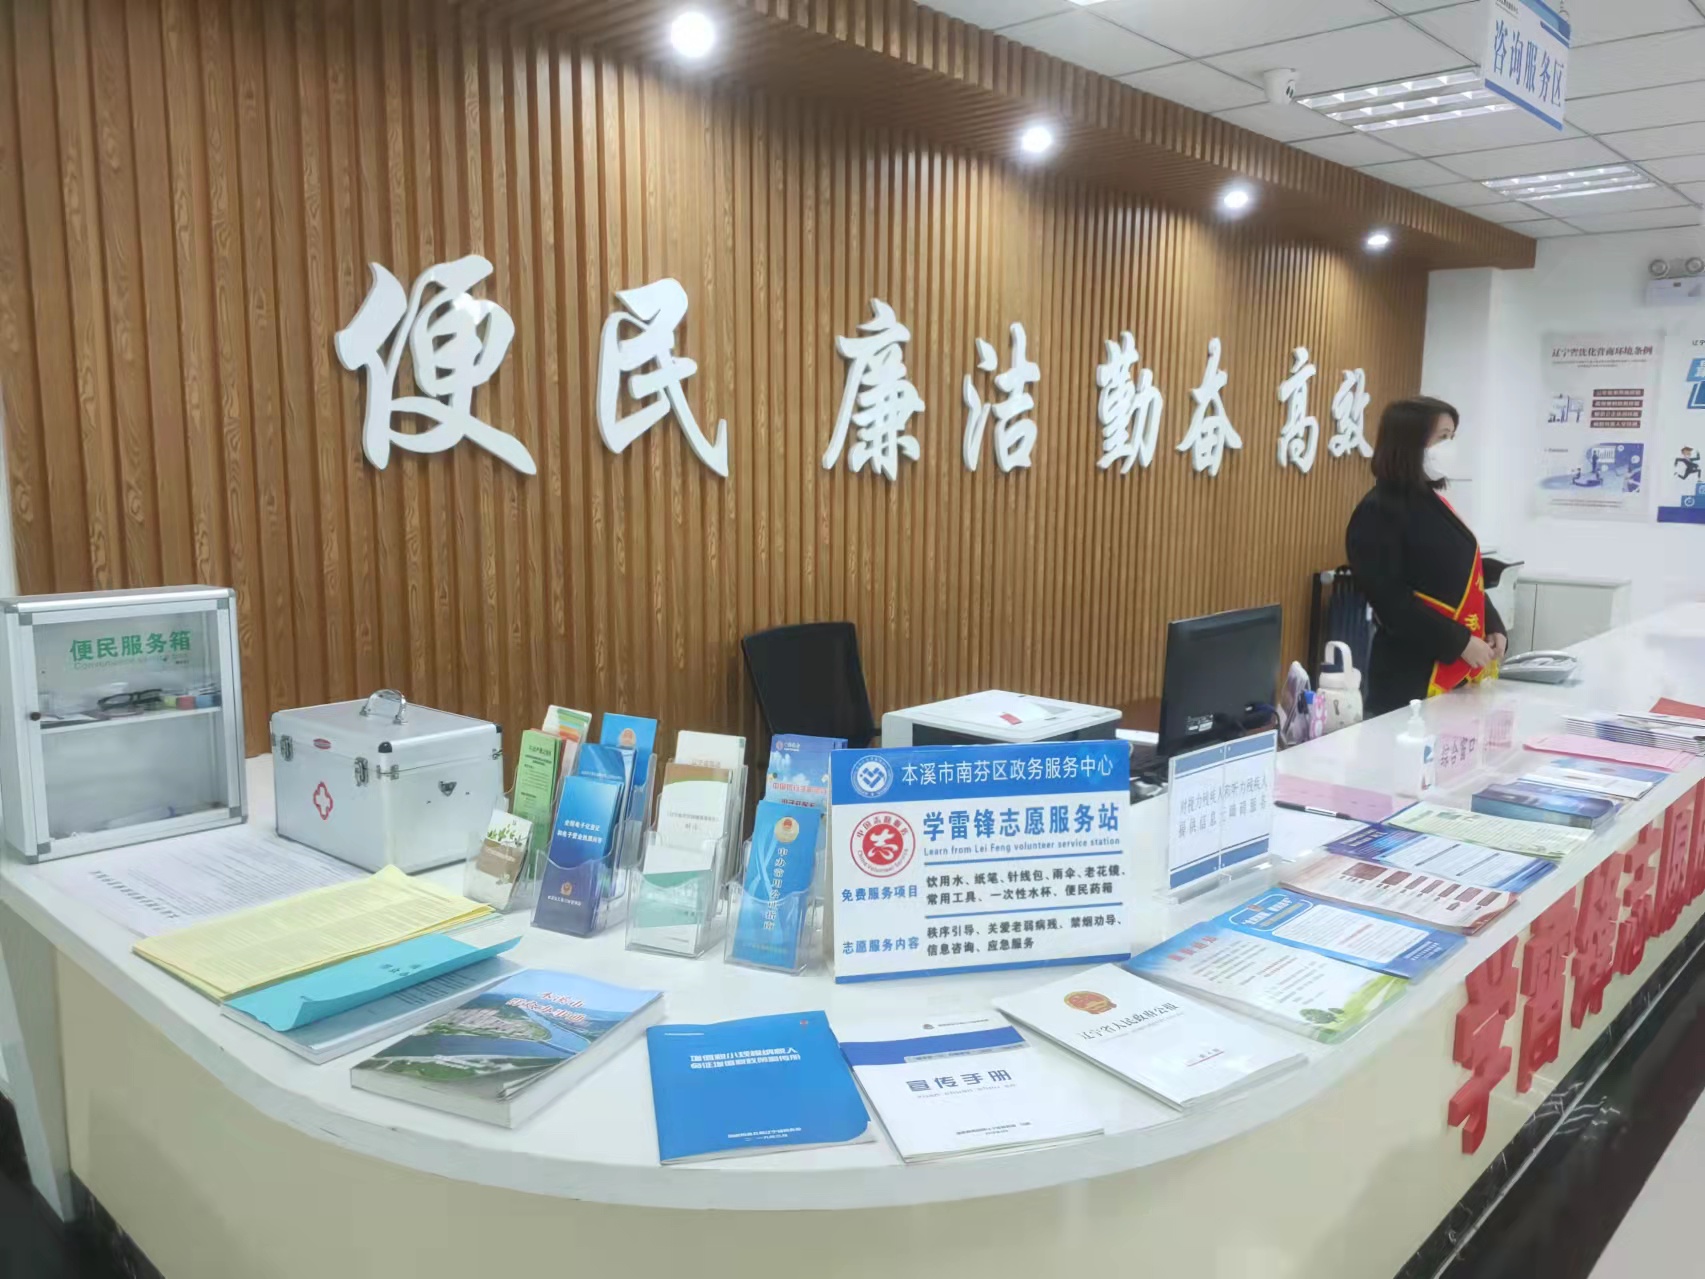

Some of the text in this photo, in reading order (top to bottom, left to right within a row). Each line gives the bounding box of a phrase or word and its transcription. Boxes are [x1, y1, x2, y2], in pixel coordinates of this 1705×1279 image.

[1493, 19, 1565, 108] 咨询服务区
[335, 254, 1374, 480] 便民 廉洁 勤奋 高效
[69, 630, 192, 661] 便民服务箱
[902, 754, 1114, 786] 本溪市南芬区政务服务中心
[923, 802, 1120, 841] 学雷锋志愿服务站
[924, 837, 1120, 856] Learn from Lei Feng volunteer service station
[841, 884, 919, 903] 免费服务项目
[842, 936, 920, 955] 志愿服务内容
[927, 937, 1035, 957] 信息咨询、应急服务
[906, 1069, 1012, 1092] 宣传手册
